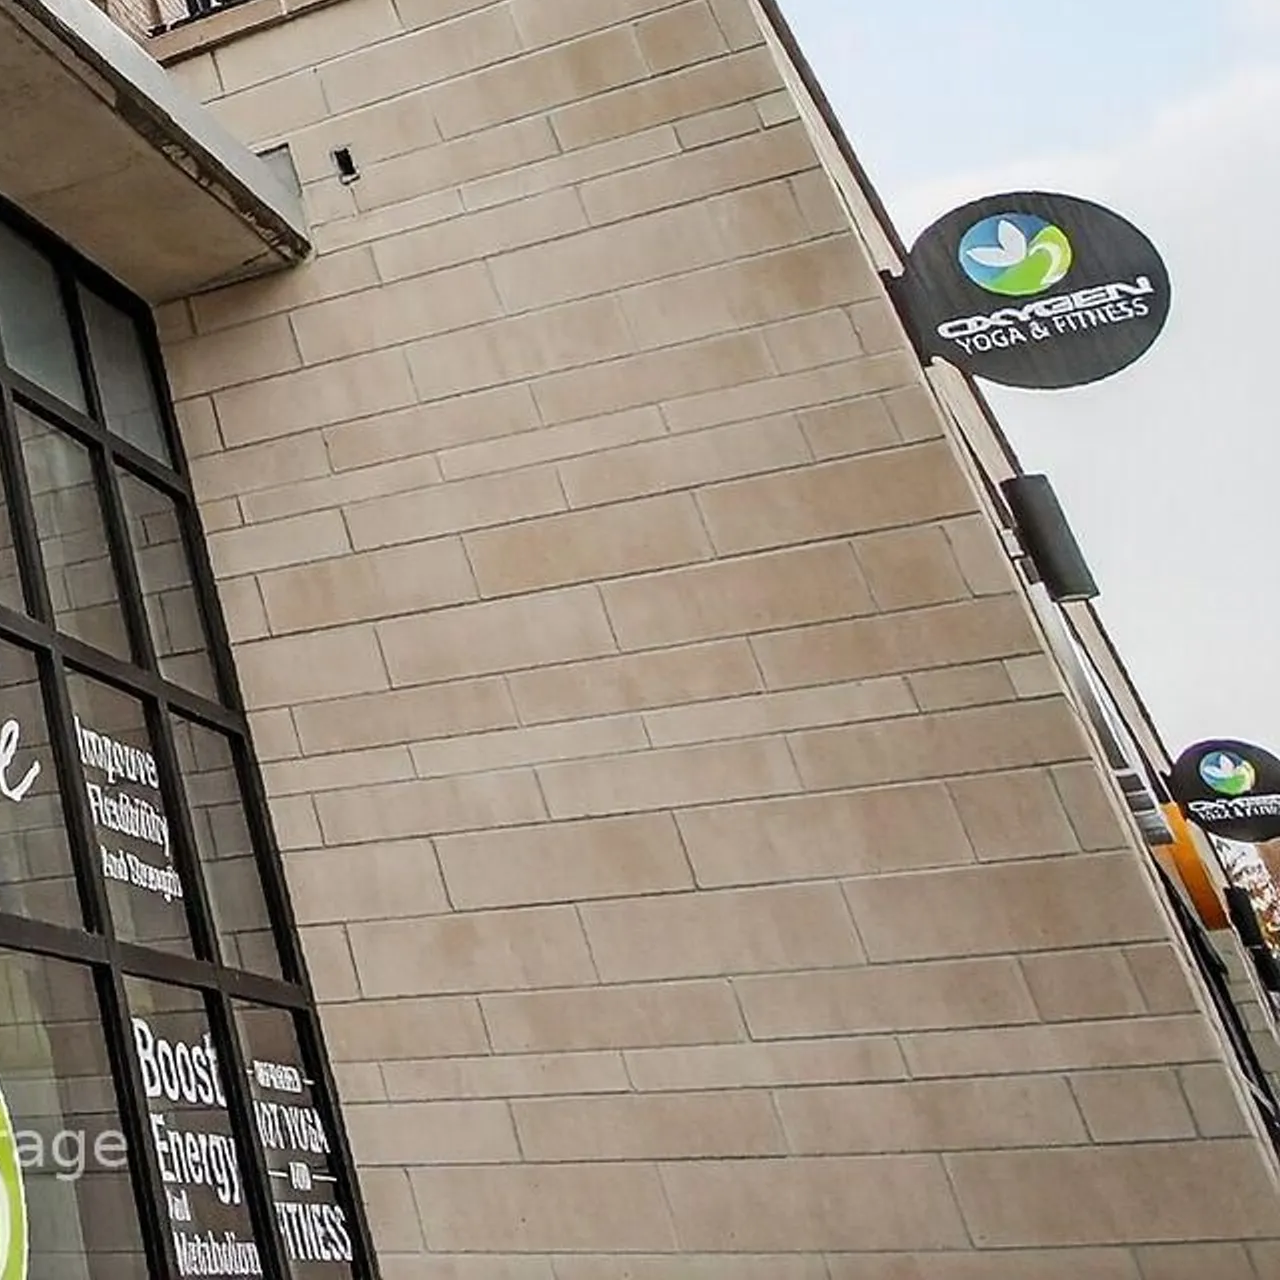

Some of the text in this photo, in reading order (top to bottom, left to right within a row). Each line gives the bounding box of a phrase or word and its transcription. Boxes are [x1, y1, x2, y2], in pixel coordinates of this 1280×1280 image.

[937, 276, 1154, 339] OXYGEN
[955, 296, 1150, 356] YOGA & FITNESS
[74, 715, 160, 789] Improve
[131, 1017, 228, 1108] Boost
[149, 1113, 241, 1204] Energy
